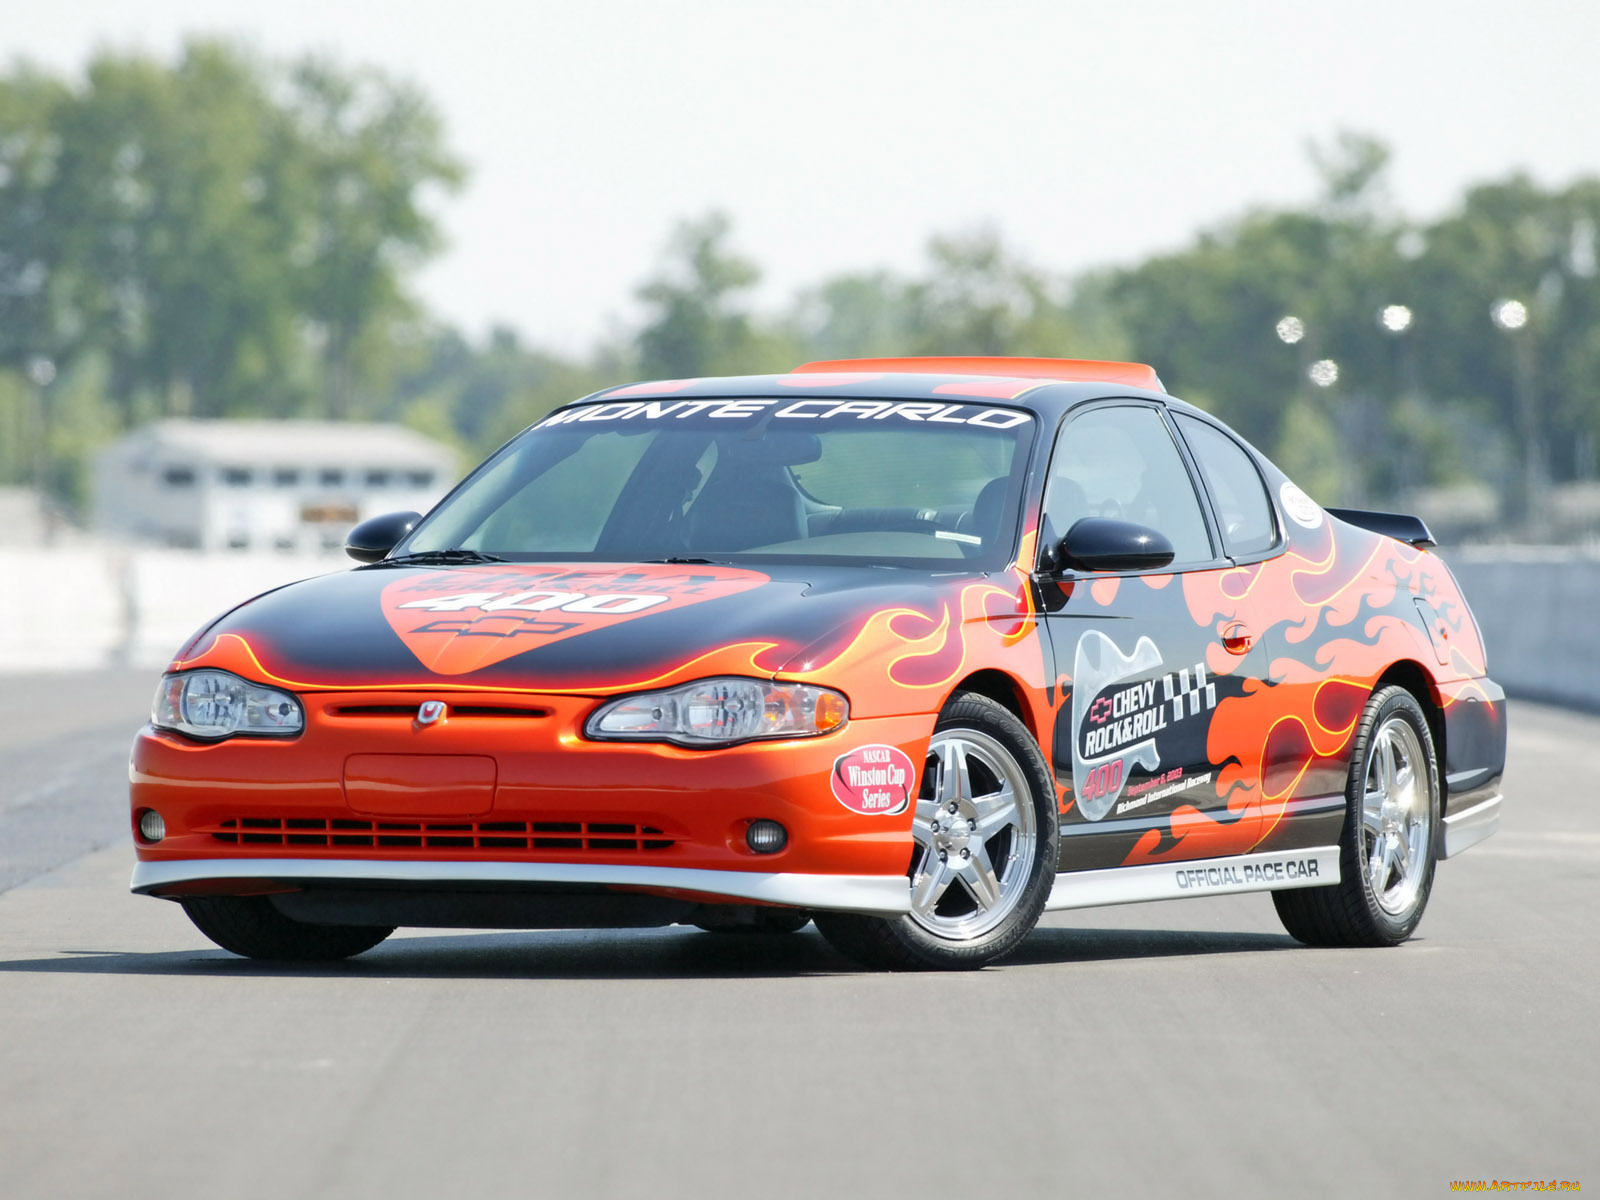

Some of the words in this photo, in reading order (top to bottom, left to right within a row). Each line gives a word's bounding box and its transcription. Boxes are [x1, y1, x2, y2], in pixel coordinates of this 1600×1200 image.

[530, 399, 779, 432] MONTE
[775, 400, 1032, 429] CARLO
[396, 591, 671, 615] 400
[1113, 680, 1156, 718] CHEVY
[1084, 704, 1168, 758] ROCK&ROLL
[863, 749, 891, 763] NASCAR
[847, 765, 887, 787] Winston
[887, 764, 906, 788] Cup
[1081, 758, 1124, 801] 400
[861, 788, 891, 809] Series
[1116, 793, 1148, 815] Richmond
[1147, 778, 1187, 804] International
[1186, 772, 1212, 789] Raceway
[1175, 866, 1243, 889] OFFICIAL
[1243, 862, 1285, 883] PACE
[1286, 858, 1320, 879] CAR
